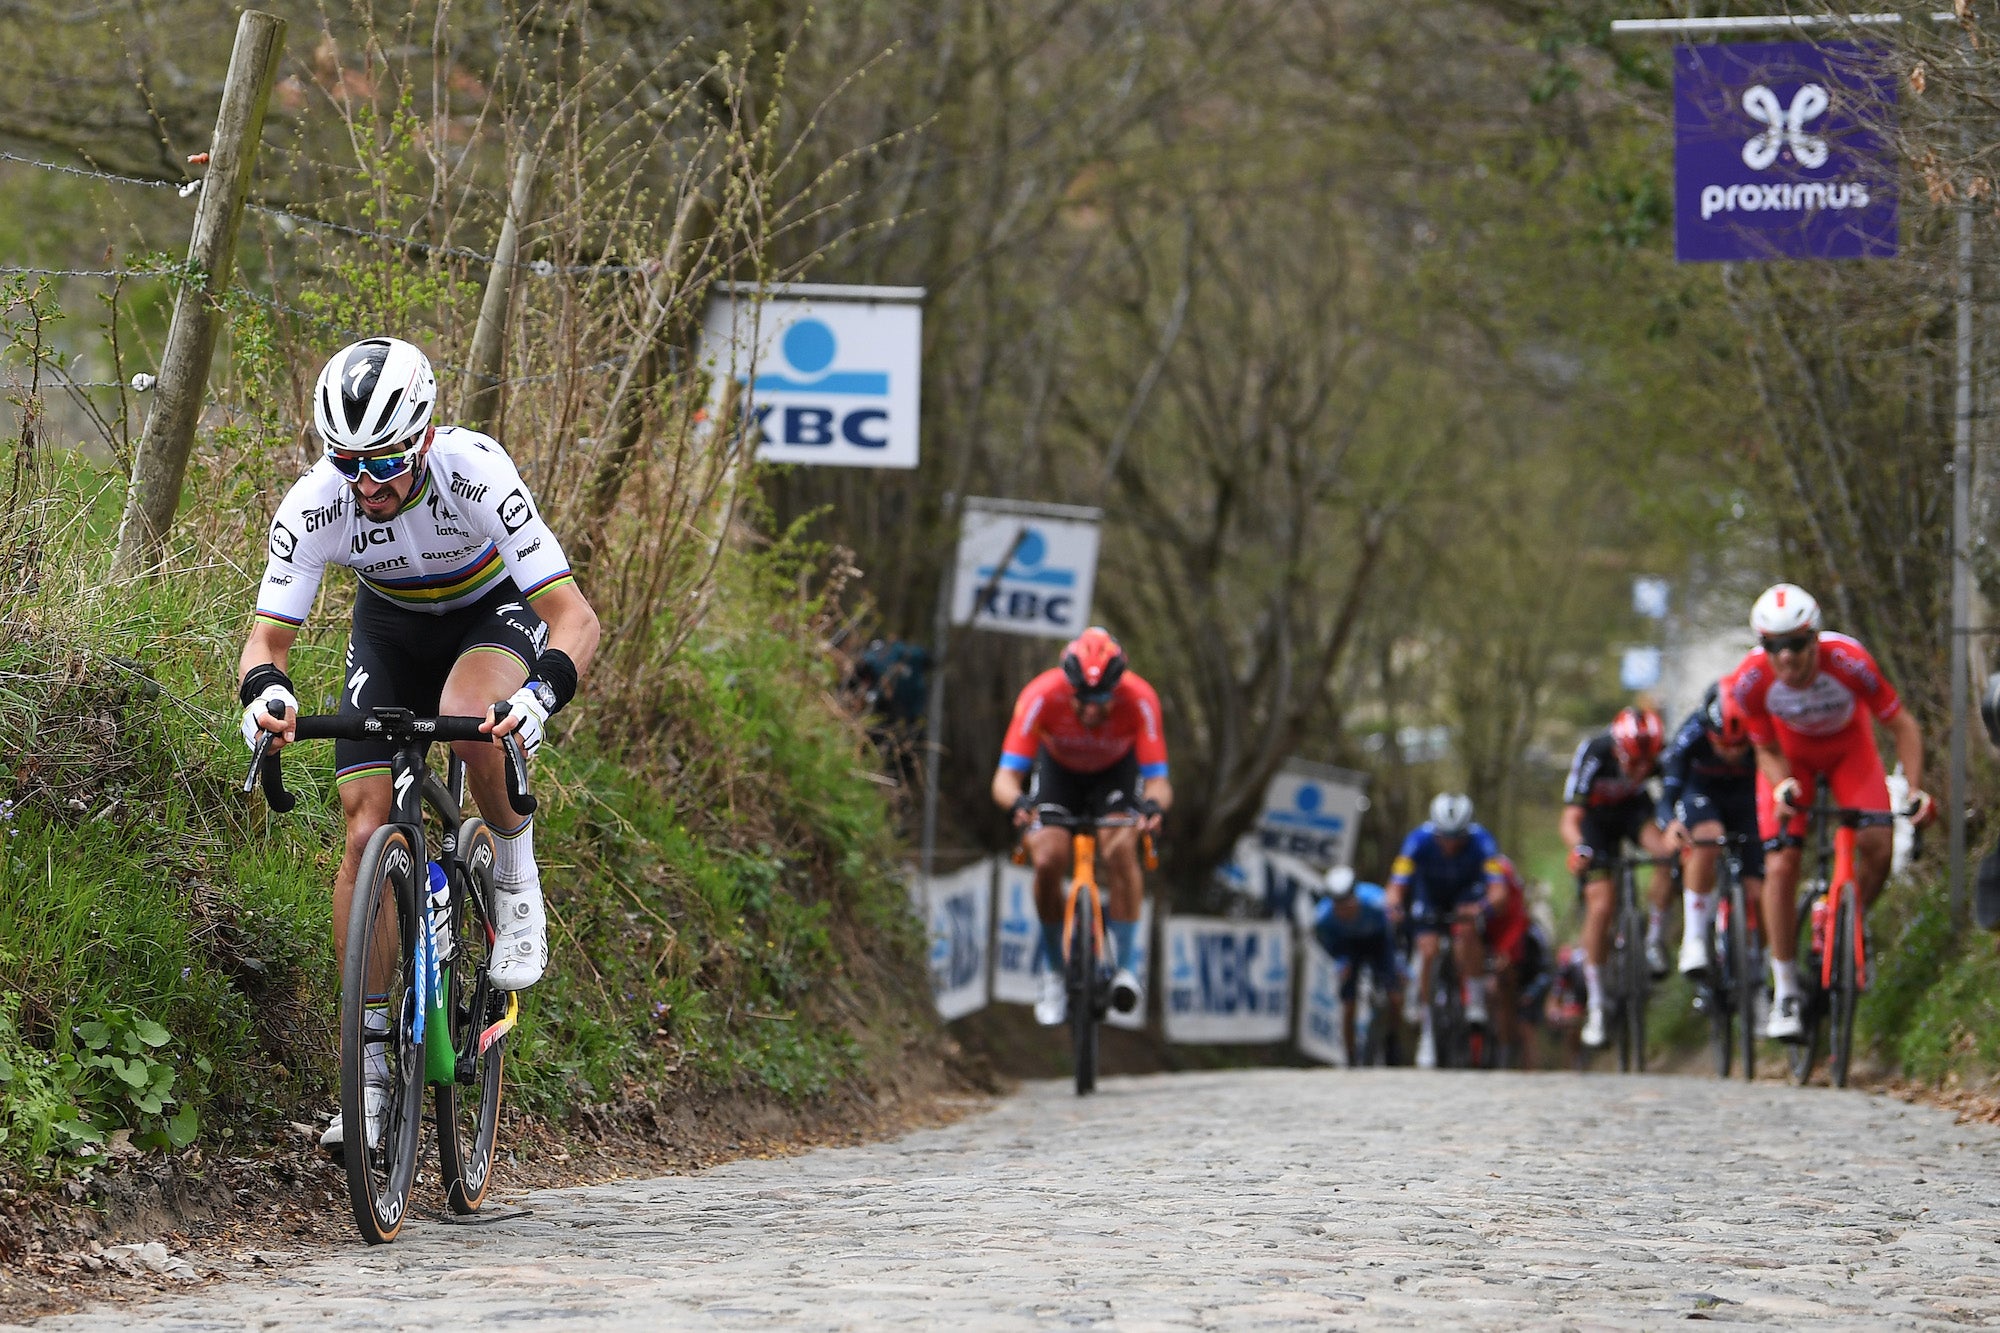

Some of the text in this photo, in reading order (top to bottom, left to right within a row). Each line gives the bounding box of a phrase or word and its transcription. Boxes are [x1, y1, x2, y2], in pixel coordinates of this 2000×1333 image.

[1700, 182, 1870, 220] proximus
[450, 479, 489, 503] crivit
[305, 497, 344, 533] crivit
[351, 526, 396, 554] UCI
